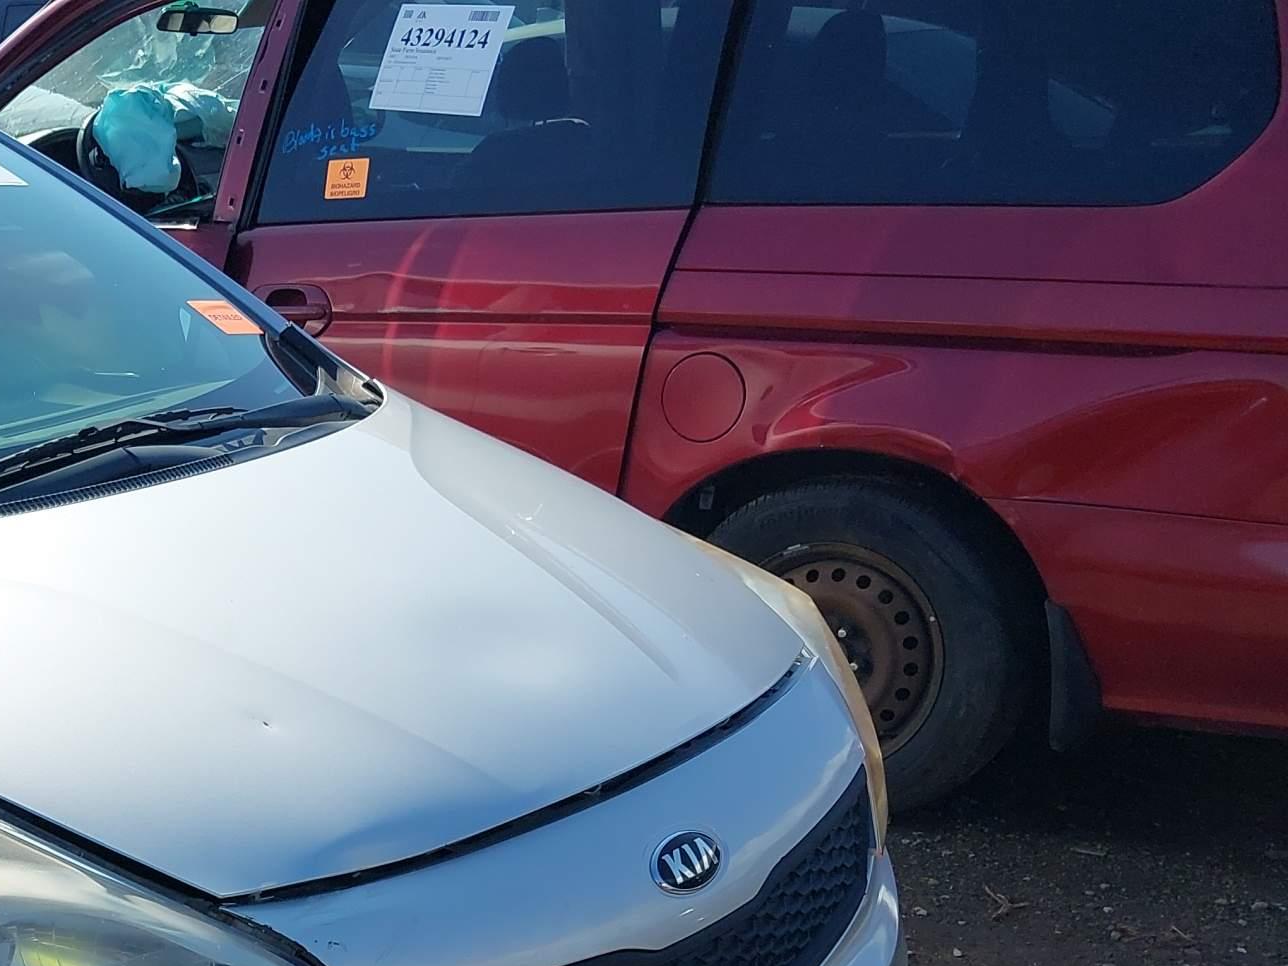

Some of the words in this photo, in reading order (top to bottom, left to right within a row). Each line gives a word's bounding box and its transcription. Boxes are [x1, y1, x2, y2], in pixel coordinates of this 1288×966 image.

[400, 27, 491, 49] 43294124
[330, 182, 361, 190] BIOHAZARD
[661, 837, 719, 885] KIA
